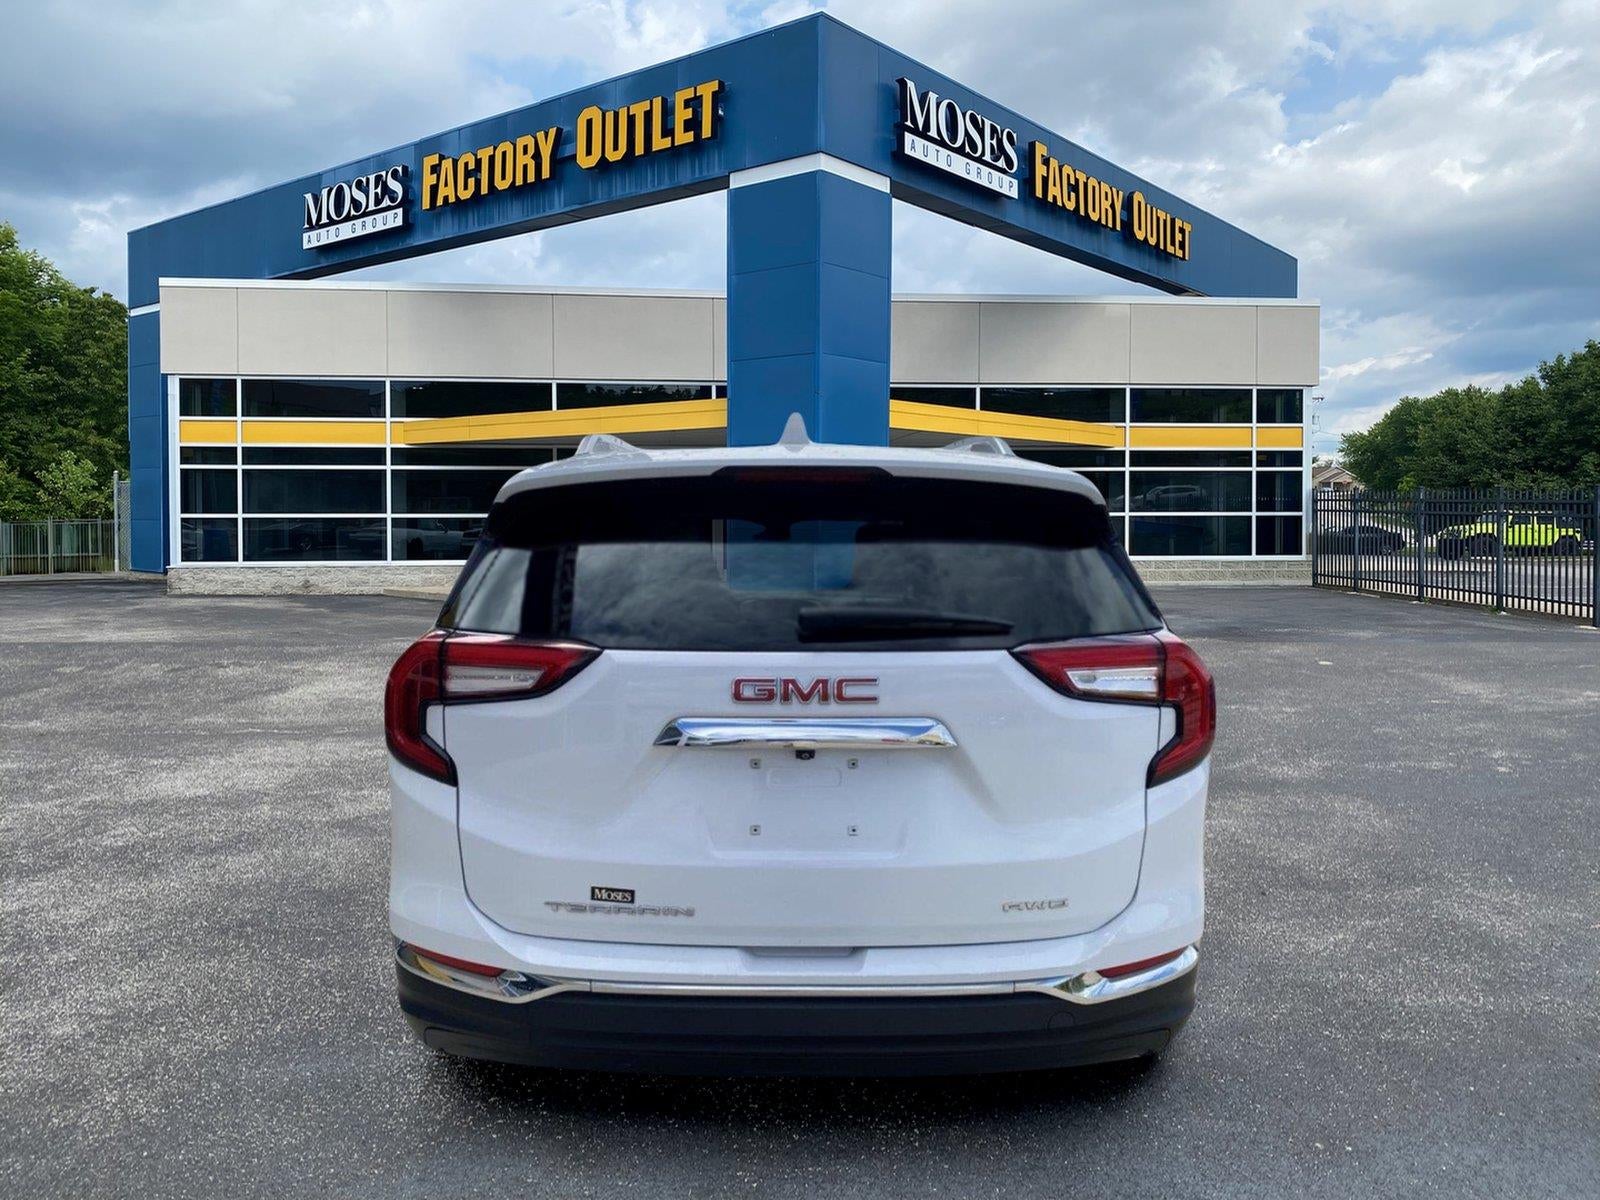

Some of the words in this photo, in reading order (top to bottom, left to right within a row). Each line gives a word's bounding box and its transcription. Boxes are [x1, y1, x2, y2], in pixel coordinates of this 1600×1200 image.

[422, 127, 558, 210] FACTORY
[577, 80, 719, 169] OUTLET
[903, 77, 1018, 173] MOSES
[303, 165, 404, 229] MOSES
[910, 138, 952, 168] AUTO
[965, 162, 1015, 192] GROUP
[307, 226, 341, 245] AUTO
[350, 212, 400, 233] GROUP
[1034, 141, 1124, 231] FACTORY
[1132, 191, 1192, 260] OUTLET
[731, 677, 879, 704] GMC
